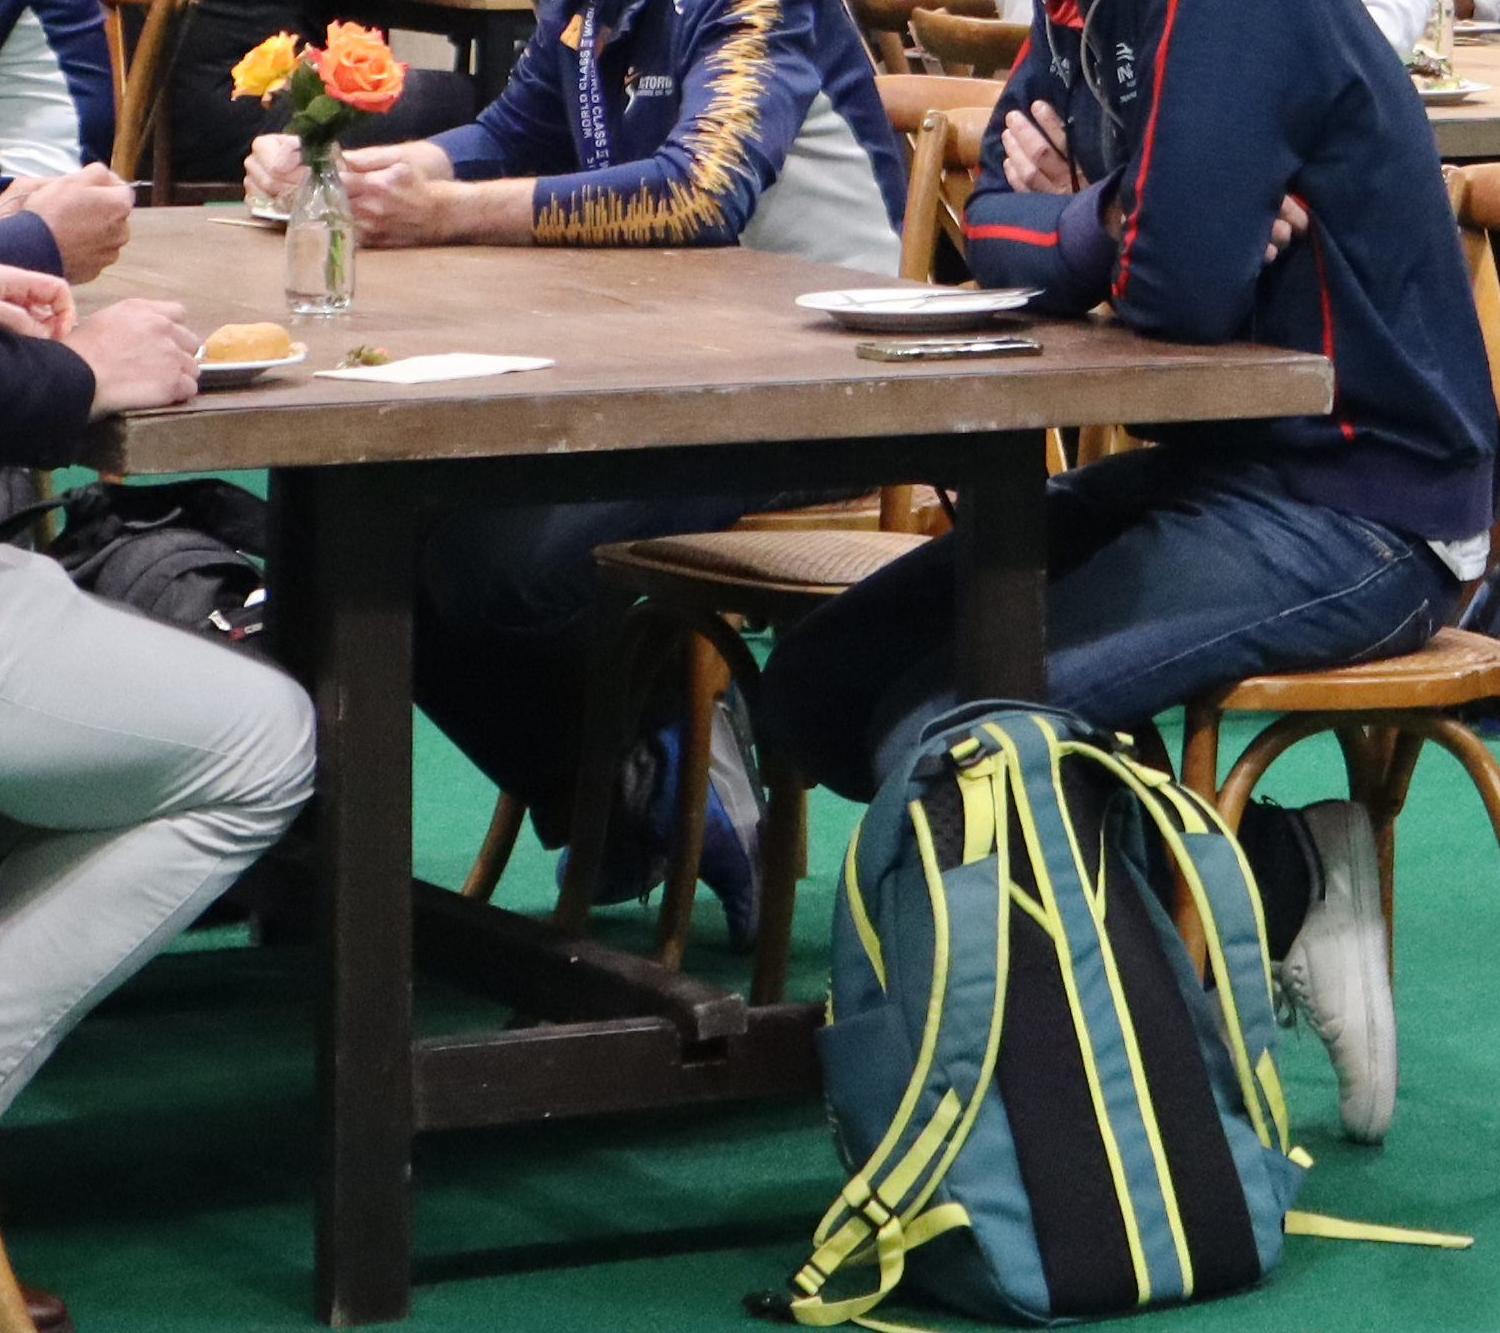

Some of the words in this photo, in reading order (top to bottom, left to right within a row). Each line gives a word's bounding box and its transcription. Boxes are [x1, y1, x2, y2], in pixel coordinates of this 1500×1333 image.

[579, 49, 591, 91] CLASS
[579, 95, 593, 140] WORLD
[592, 106, 607, 148] CLASS
